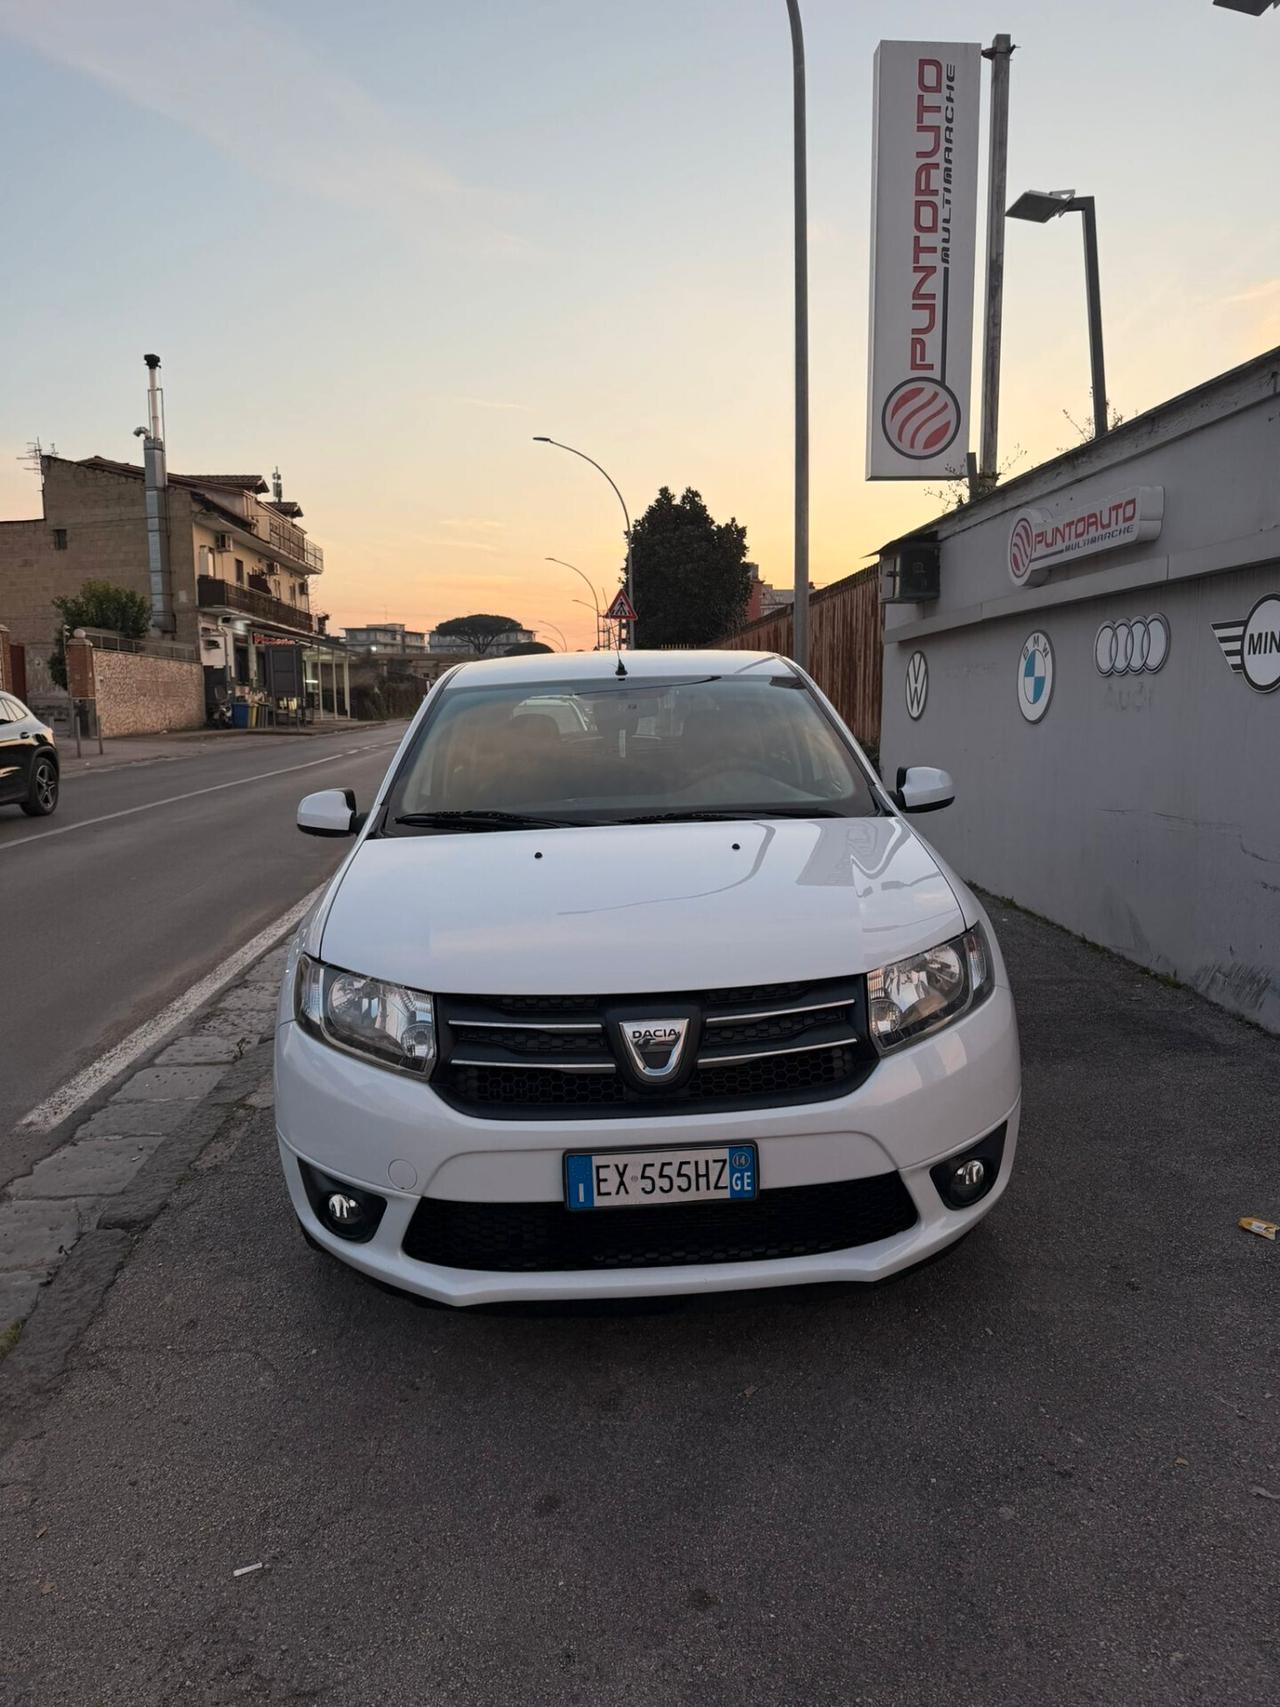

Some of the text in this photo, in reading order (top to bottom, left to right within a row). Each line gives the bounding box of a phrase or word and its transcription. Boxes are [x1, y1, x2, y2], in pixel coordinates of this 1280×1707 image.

[941, 63, 956, 265] MULTIMARCHE
[910, 58, 943, 371] PUNTOAUTO
[1033, 498, 1137, 553] PUNTOAUTO
[1064, 524, 1135, 553] MULTIMARCHE
[632, 1028, 678, 1039] DACIA
[595, 1163, 630, 1197] EX
[640, 1158, 729, 1195] 555HZ
[732, 1171, 752, 1191] GE
